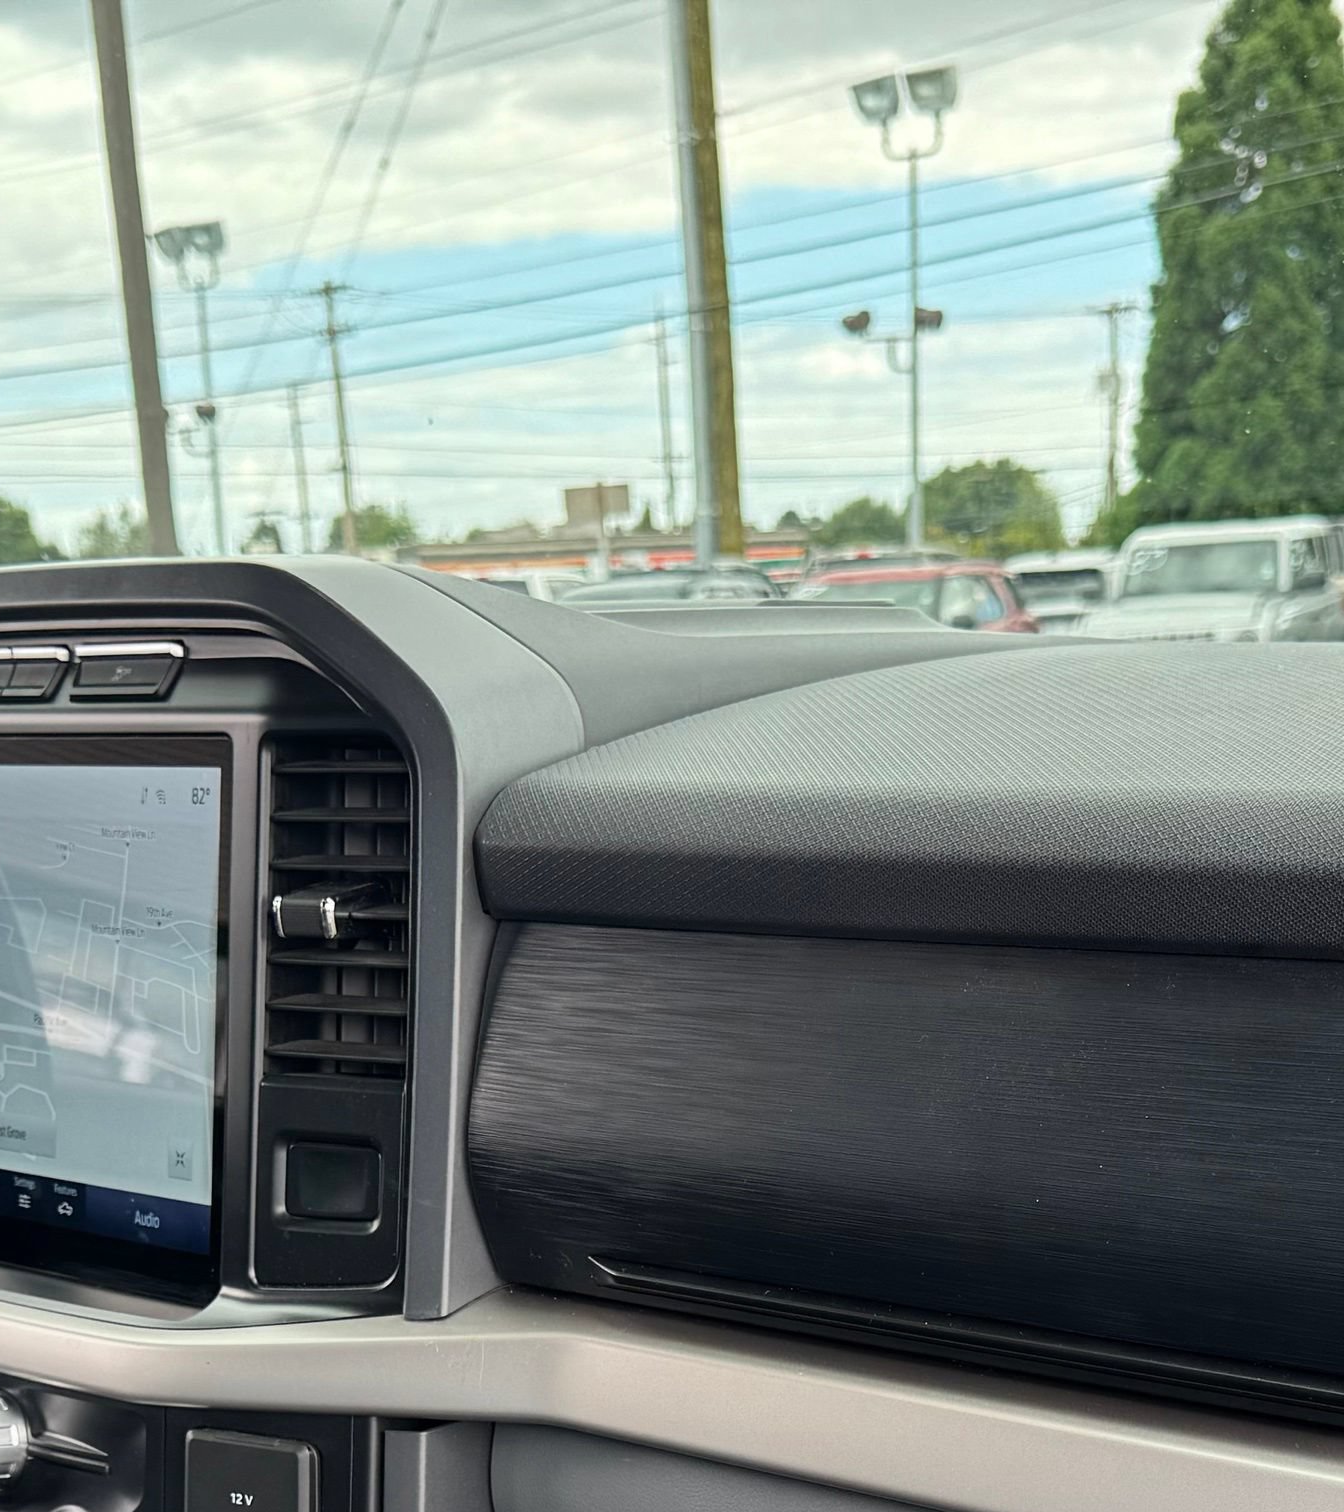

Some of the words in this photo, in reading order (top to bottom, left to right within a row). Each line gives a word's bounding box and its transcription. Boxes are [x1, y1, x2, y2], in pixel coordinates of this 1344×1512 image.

[7, 1127, 27, 1141] Grove
[134, 1210, 160, 1229] Audio
[230, 1492, 243, 1505] 12
[244, 1494, 254, 1506] V
